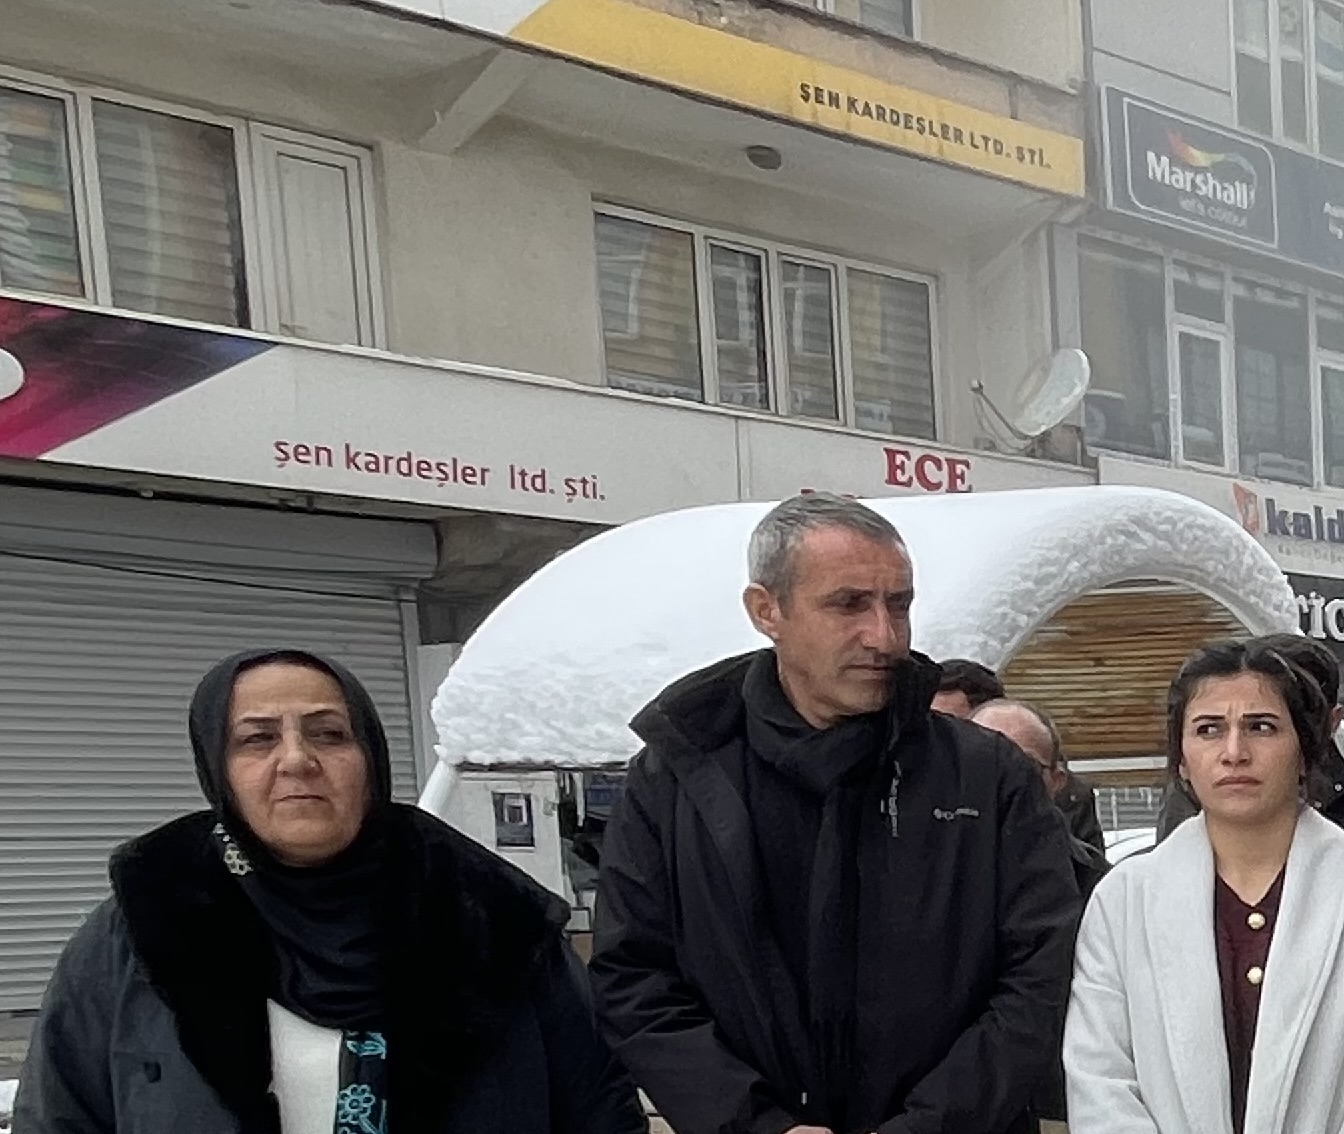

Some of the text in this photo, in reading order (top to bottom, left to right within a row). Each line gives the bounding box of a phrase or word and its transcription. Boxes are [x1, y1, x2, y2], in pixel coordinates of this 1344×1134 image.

[799, 82, 841, 110] ŞEN
[846, 95, 964, 147] KARDEŞLER
[969, 131, 1012, 158] LTD.
[1146, 149, 1248, 210] Marshall
[273, 440, 606, 504] şen kardeşler ltd. şti.
[882, 446, 975, 494] ECE
